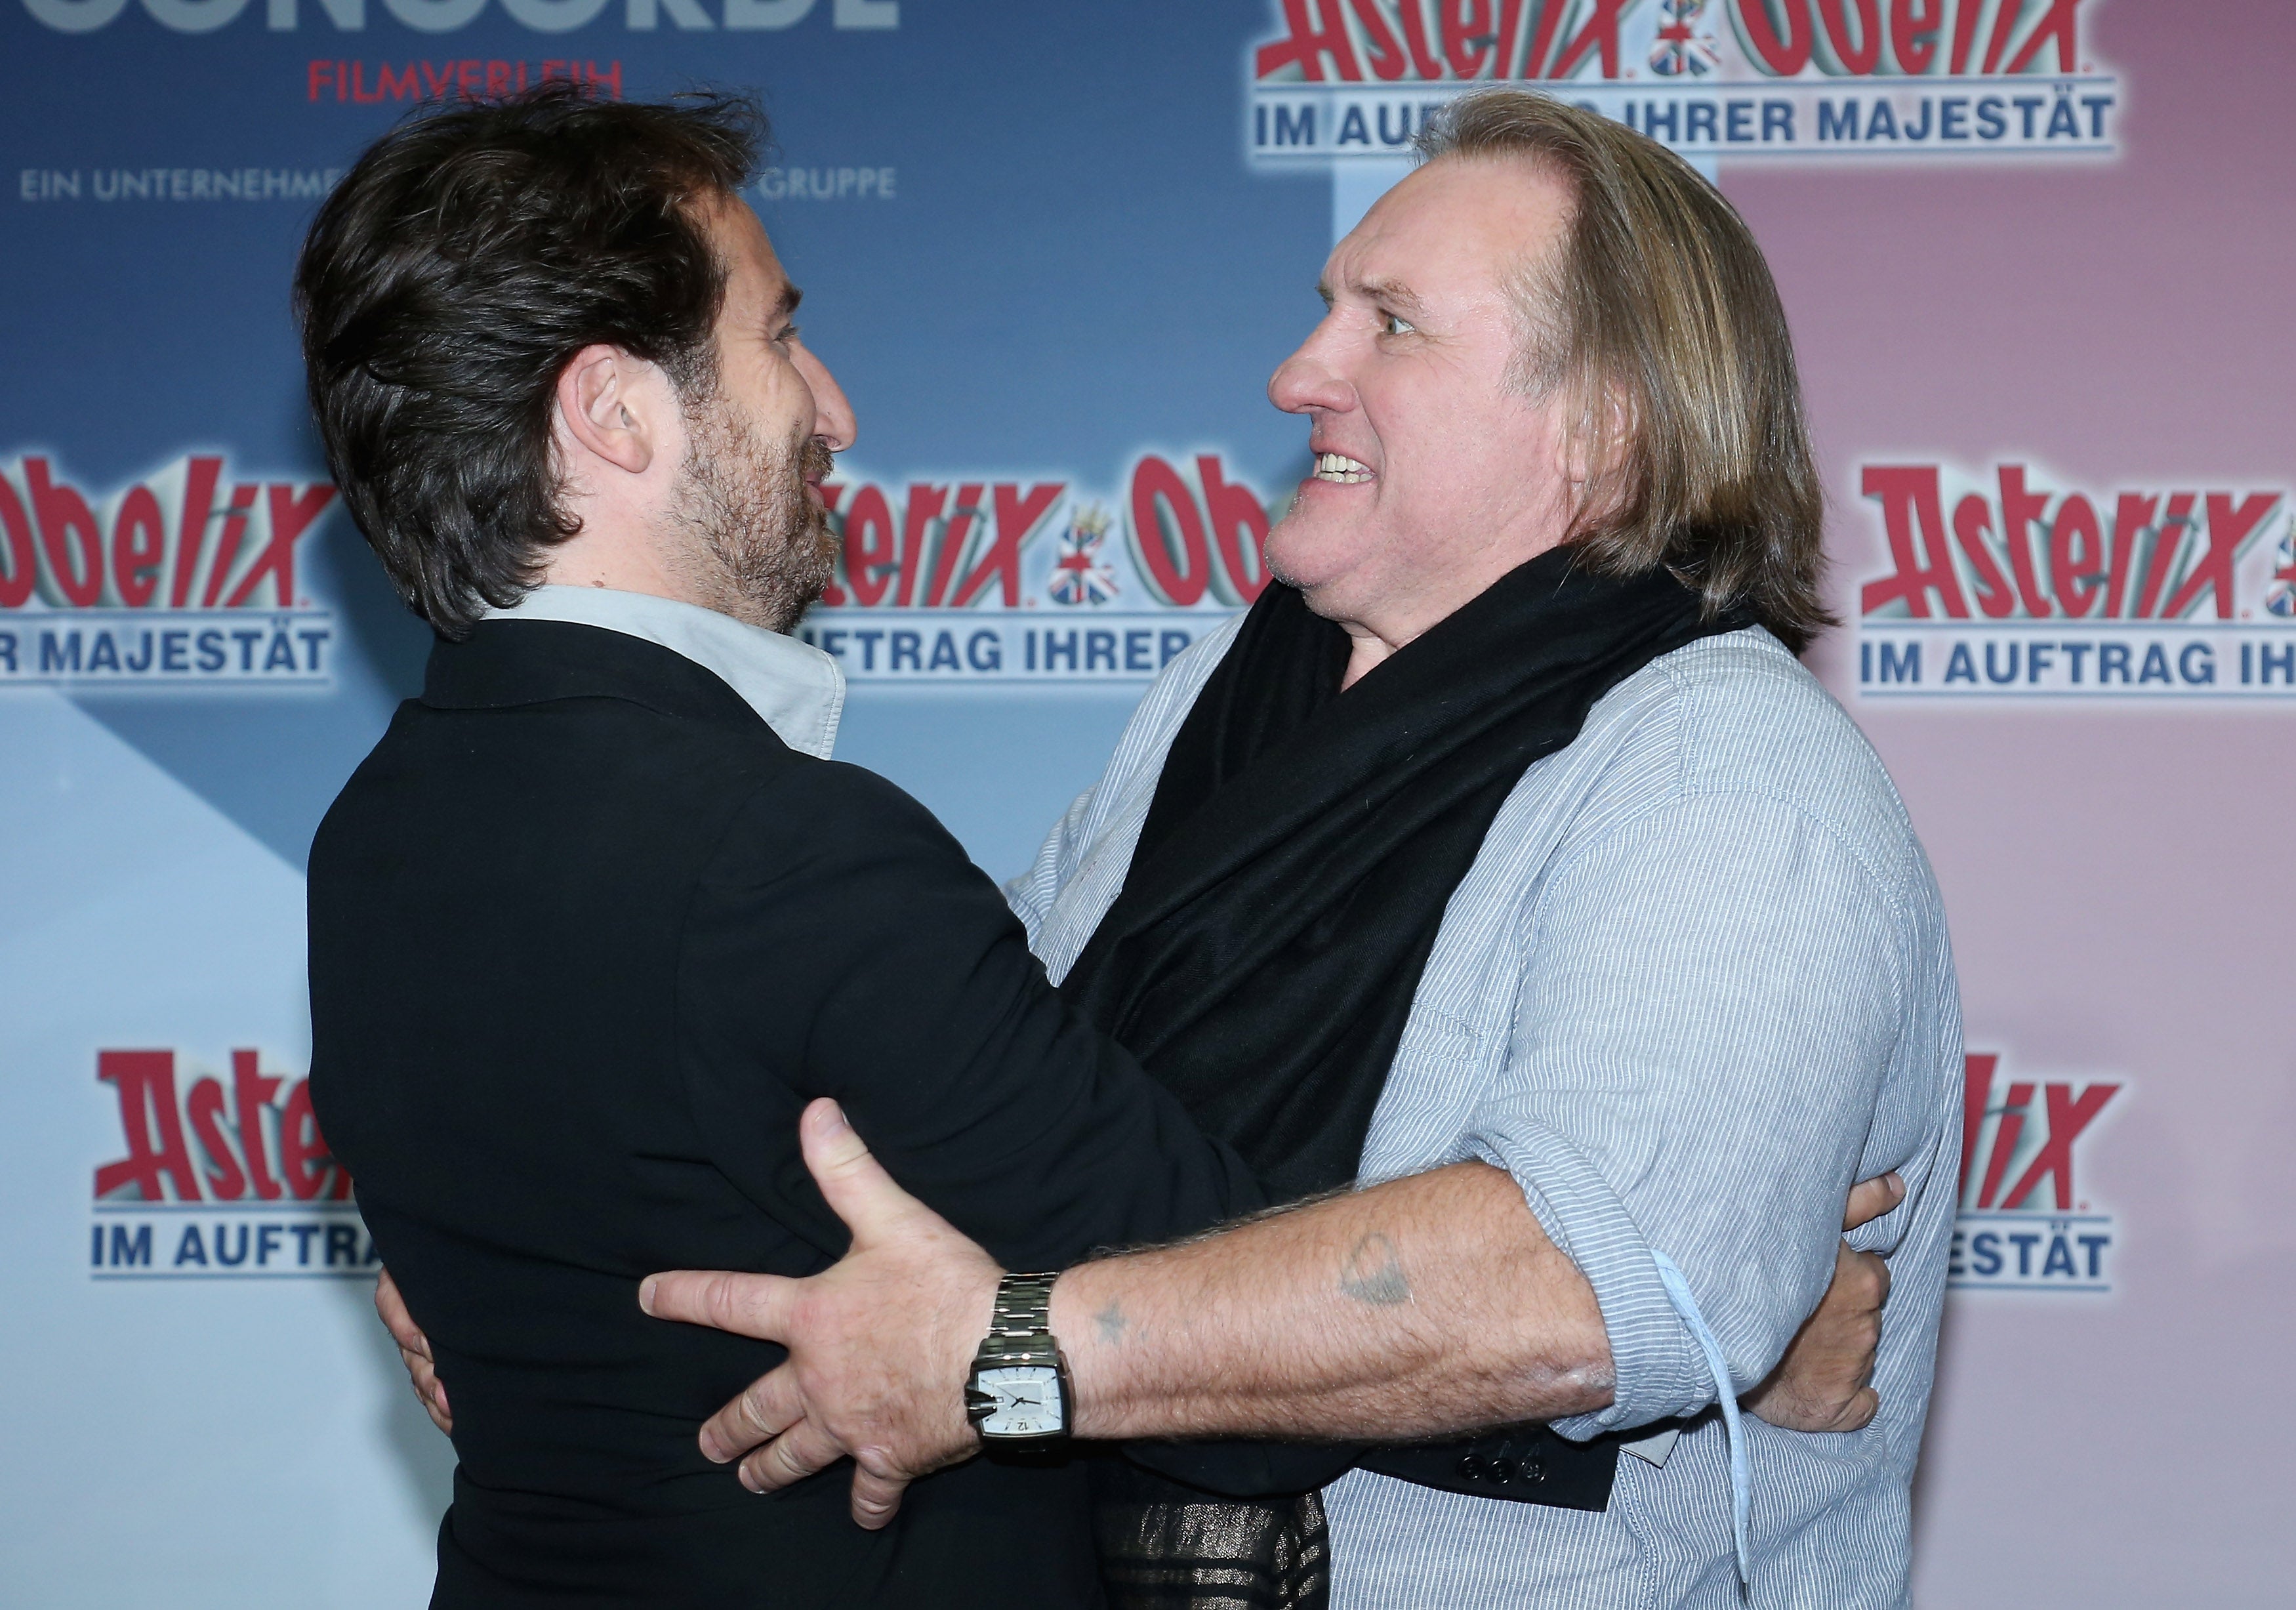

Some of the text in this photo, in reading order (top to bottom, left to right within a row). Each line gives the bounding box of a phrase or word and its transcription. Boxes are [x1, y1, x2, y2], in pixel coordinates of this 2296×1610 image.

[1255, 104, 1315, 146] IM
[1626, 101, 1796, 142] IHRER
[1817, 85, 2115, 140] MAJESTÄT
[20, 169, 81, 199] EIN
[759, 167, 897, 198] GRUPPE
[1861, 464, 2282, 619] Asterix
[39, 619, 331, 673] MAJESTÄT
[1860, 642, 1921, 684] IM
[1944, 642, 2216, 684] AUFTRAG
[91, 1225, 152, 1267] IM
